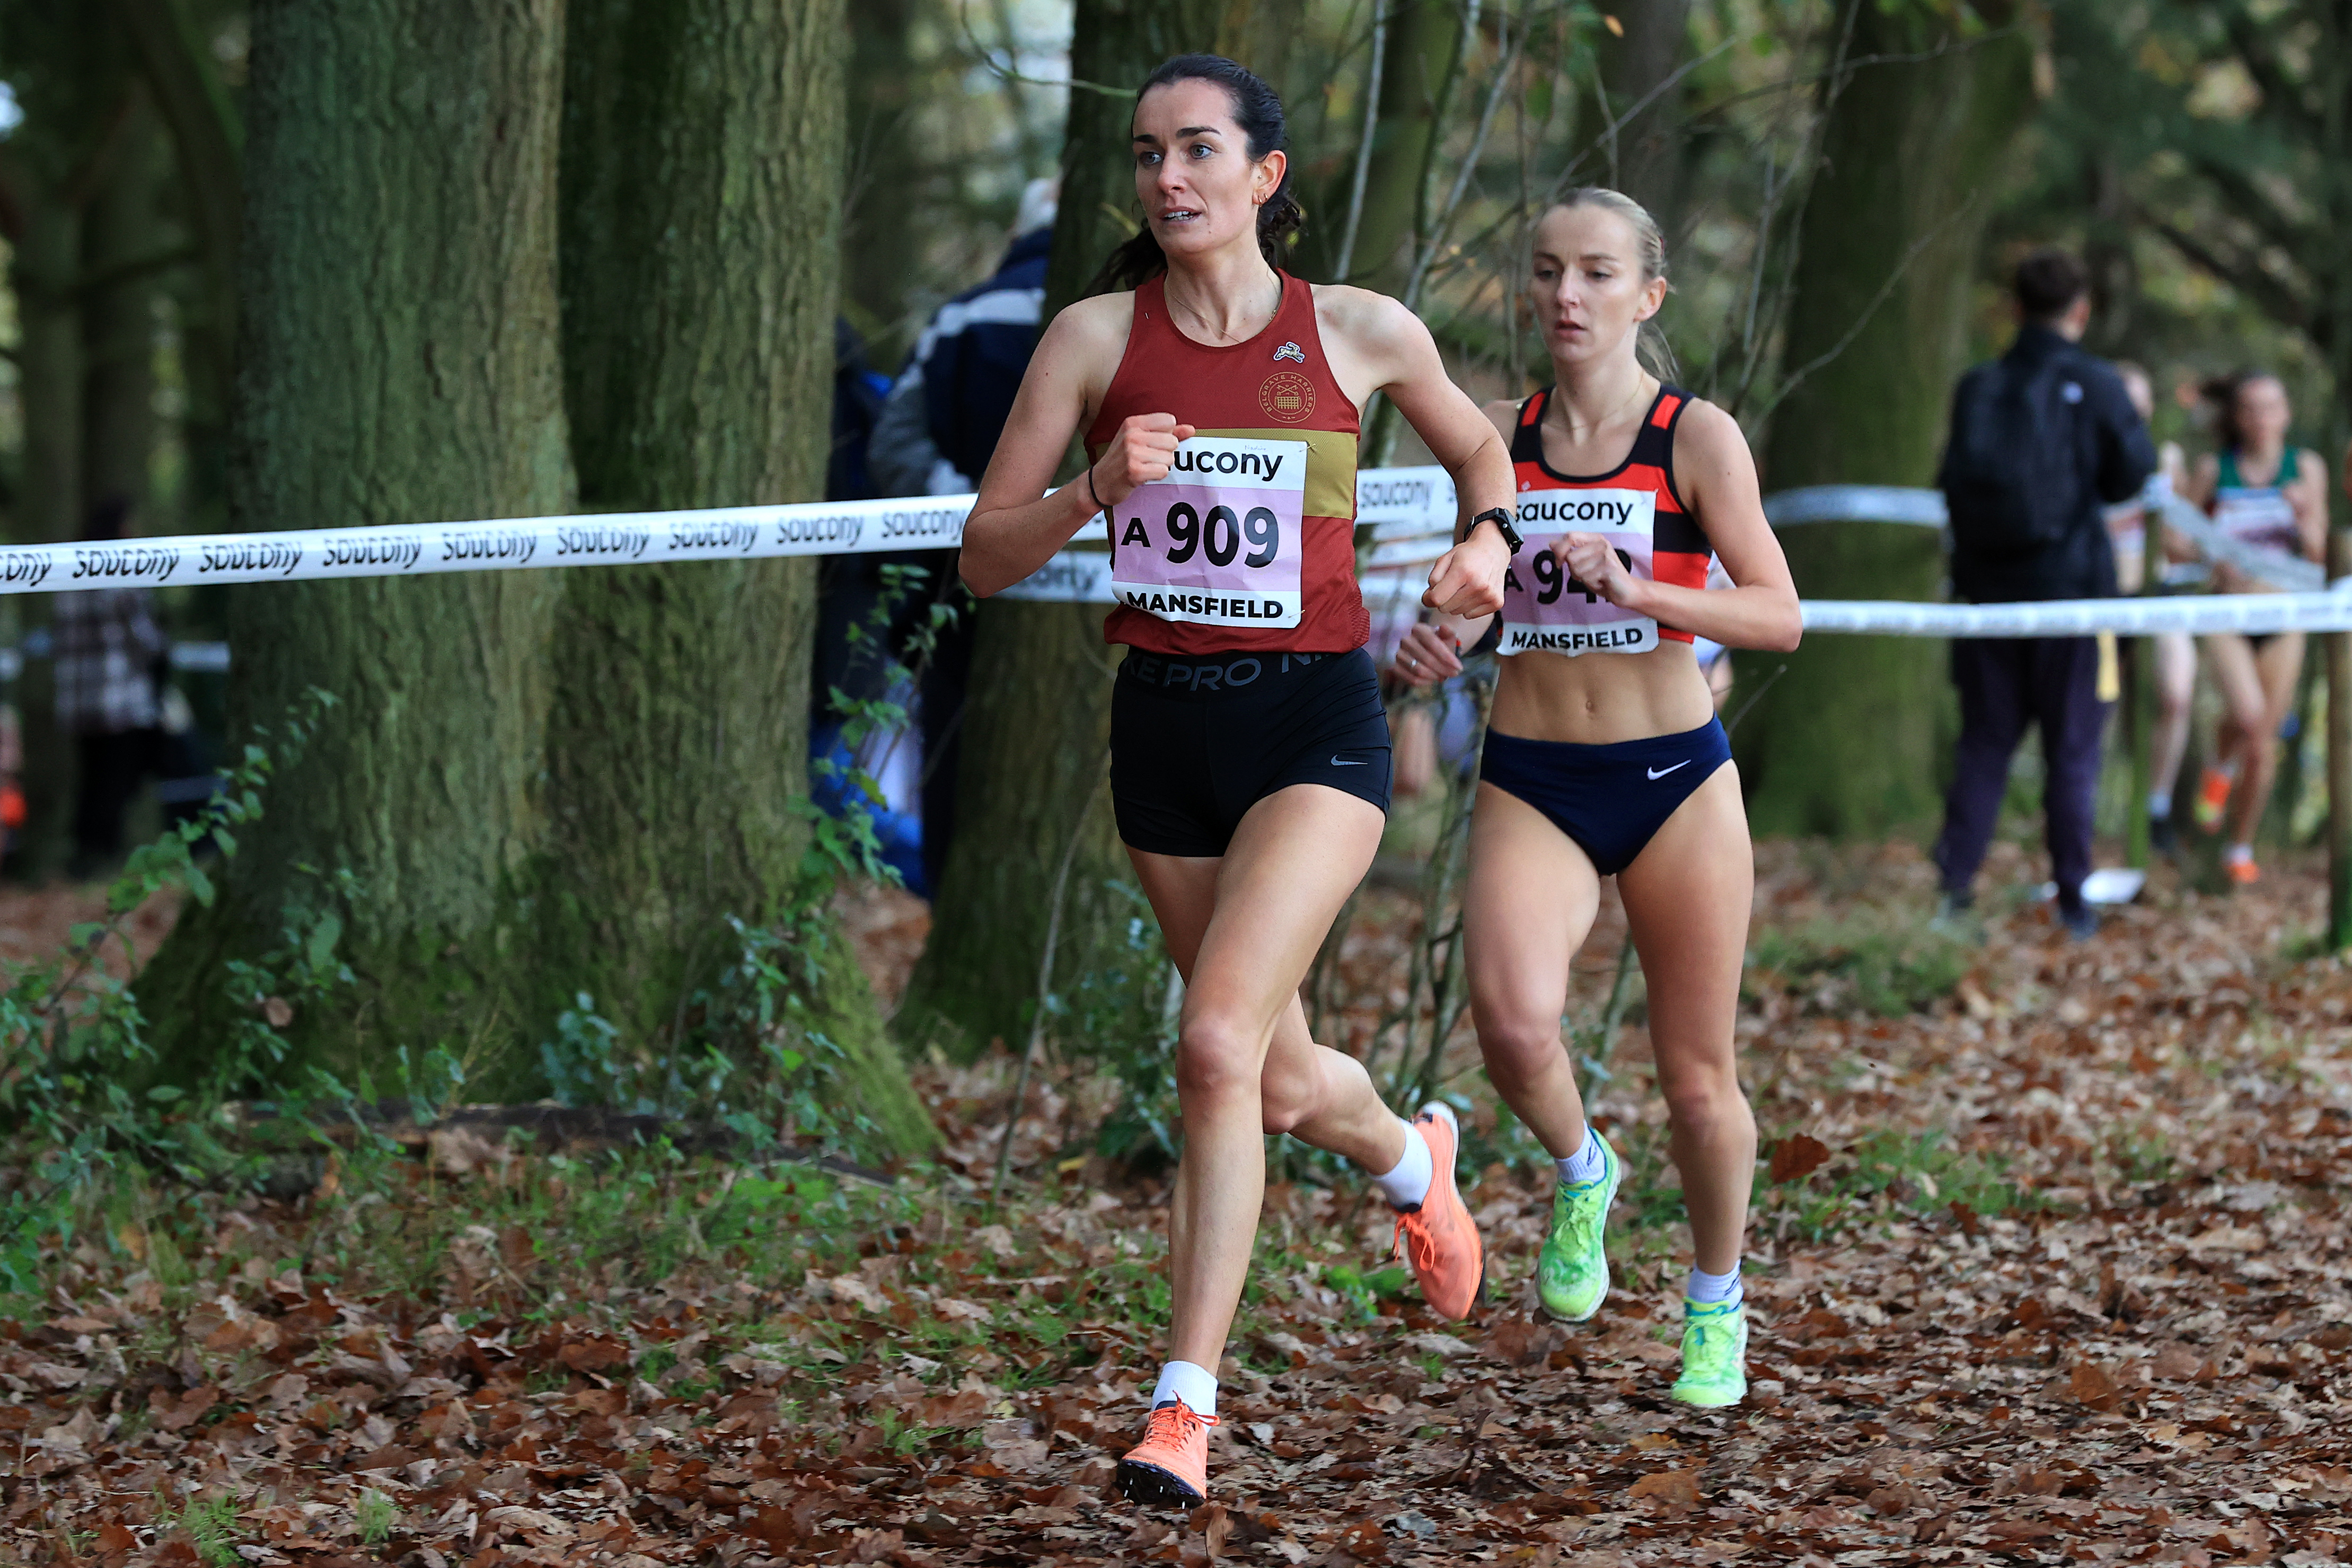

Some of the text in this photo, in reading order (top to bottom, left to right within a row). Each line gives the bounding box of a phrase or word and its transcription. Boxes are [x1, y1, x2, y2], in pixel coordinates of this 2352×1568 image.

[1262, 374, 1314, 413] BELGRAVE HARRIERS
[1168, 450, 1283, 482] ucony
[0, 553, 51, 587] ony
[72, 548, 179, 582] saucony
[199, 541, 302, 575] saucony
[323, 535, 421, 569] saucony
[442, 530, 536, 563] saucony
[557, 525, 650, 559] saucony
[668, 519, 759, 552] saucony
[777, 514, 864, 547] saucony
[1121, 501, 1279, 568] A 909
[1126, 586, 1283, 619] MANSFIELD
[1511, 628, 1643, 650] MANSFIELD
[1162, 657, 1262, 692] PRO
